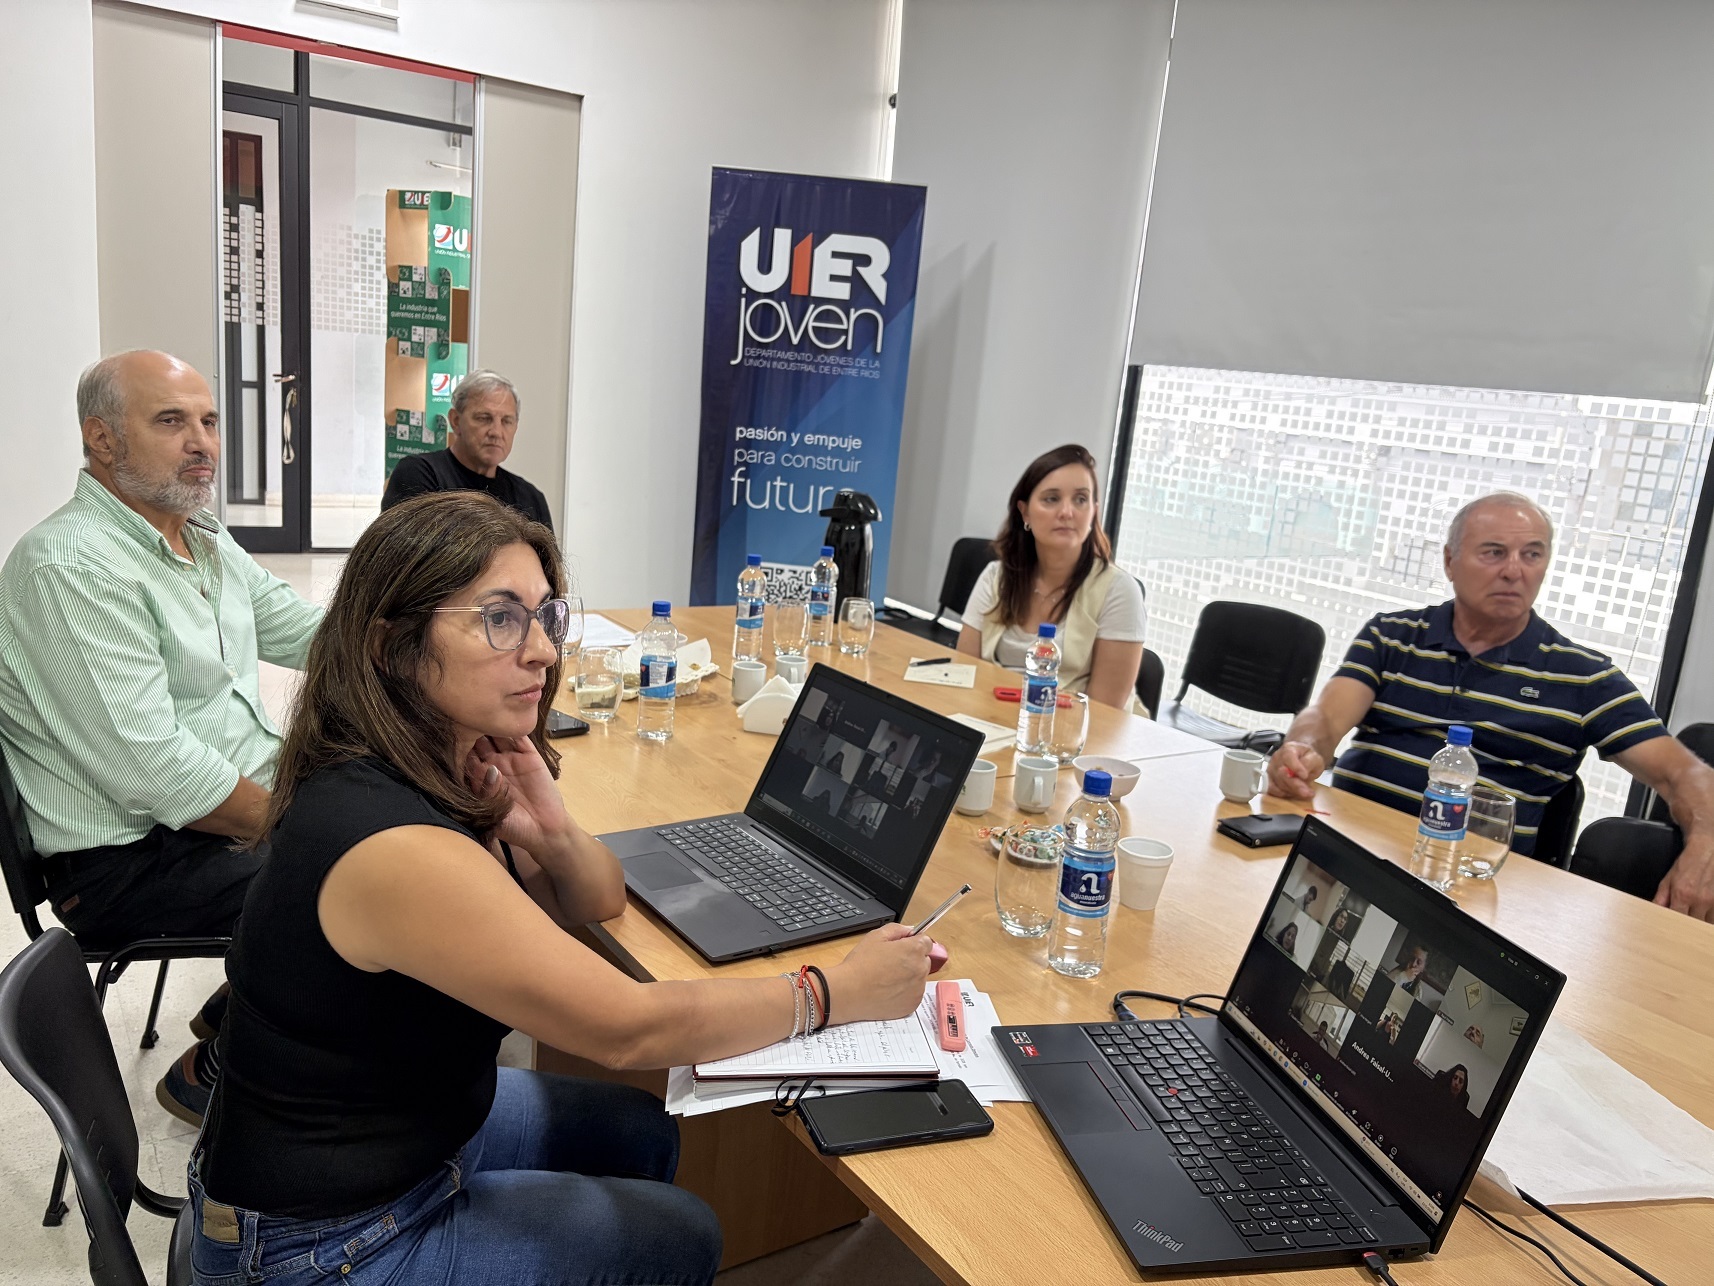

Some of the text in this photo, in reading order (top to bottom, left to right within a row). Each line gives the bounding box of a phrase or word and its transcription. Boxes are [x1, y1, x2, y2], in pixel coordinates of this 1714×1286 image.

[730, 287, 884, 365] joven
[744, 348, 813, 362] DEPARTAMENTO
[855, 358, 868, 367] DE
[868, 359, 880, 368] LA
[772, 360, 818, 373] INDUSTRIAL
[819, 366, 831, 374] DE
[832, 366, 858, 377] ENTRE
[736, 426, 862, 451] pasión y empuje
[734, 448, 862, 473] para construir
[730, 466, 855, 514] futur
[1352, 1042, 1370, 1060] Andrea
[1132, 1220, 1184, 1252] ThinkPad
